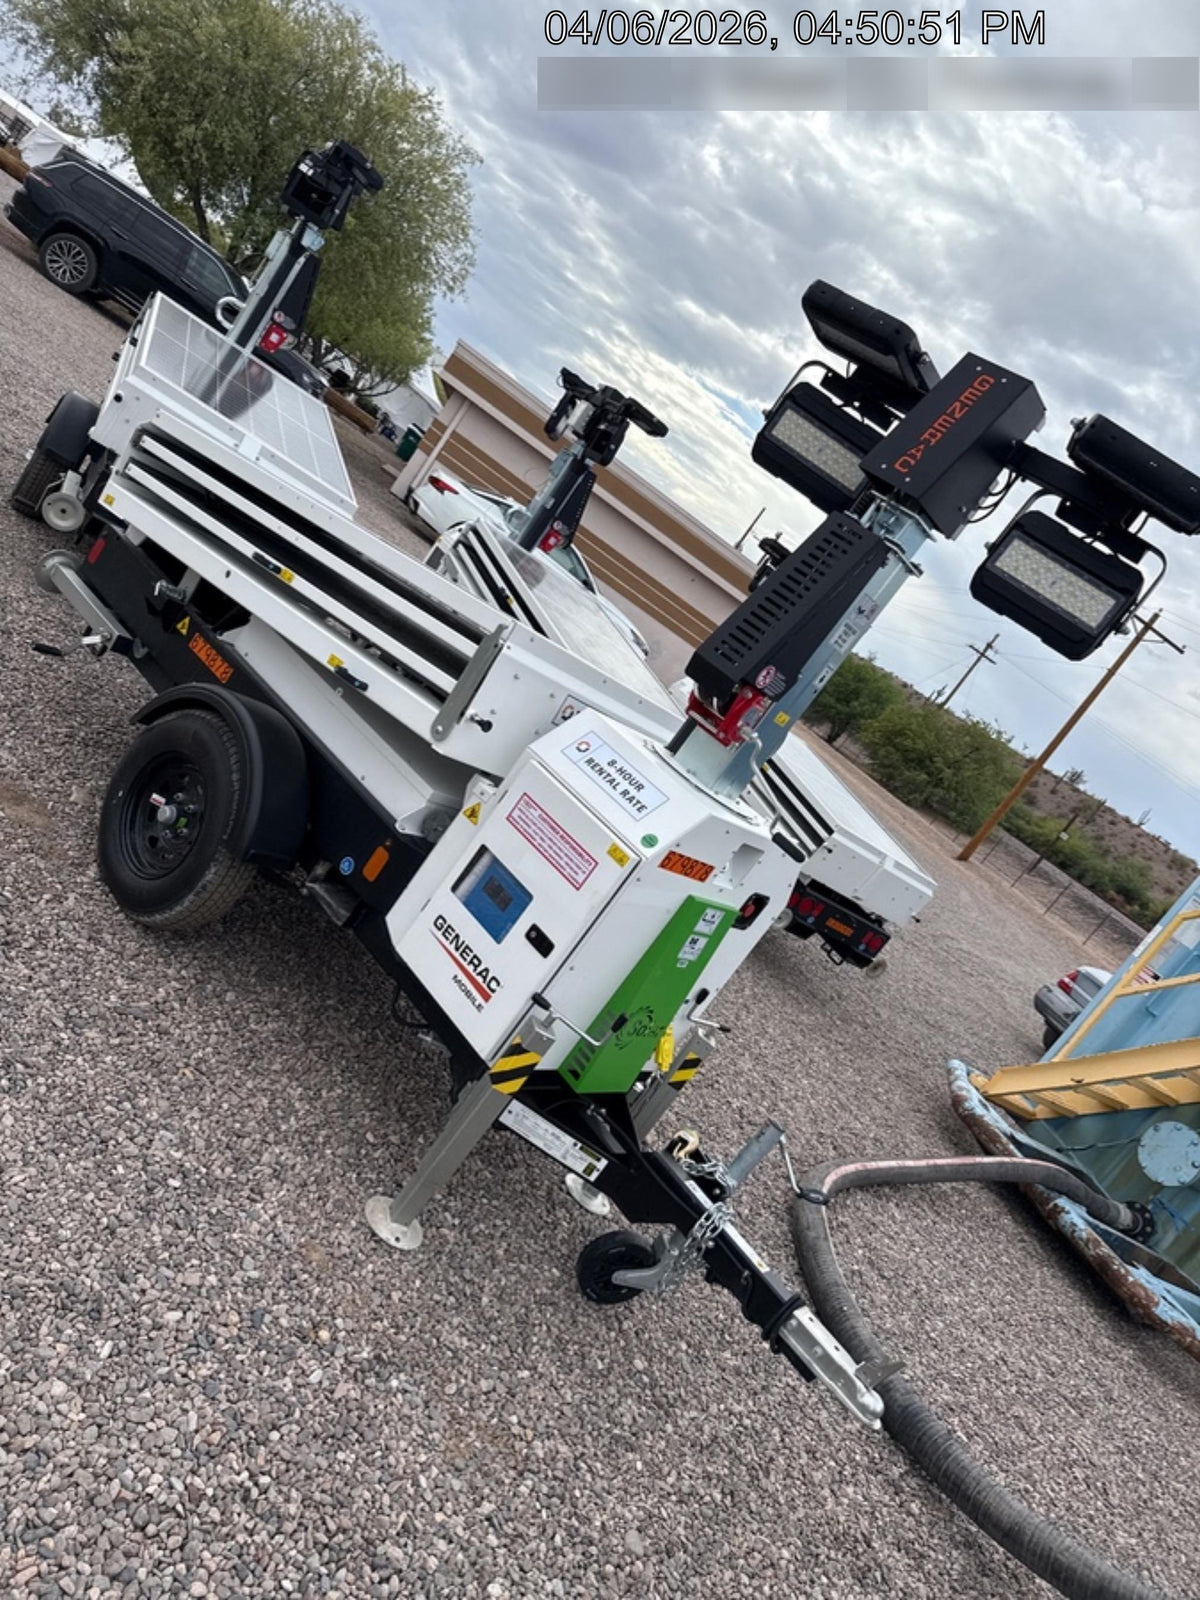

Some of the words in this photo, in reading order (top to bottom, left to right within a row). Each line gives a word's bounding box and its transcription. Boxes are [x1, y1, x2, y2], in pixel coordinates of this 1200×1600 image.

[894, 373, 996, 474] GENERAC
[584, 758, 620, 792] RENTAL
[620, 788, 648, 814] RATE
[607, 758, 645, 793] 8-HOUR
[433, 914, 501, 994] GENERAC
[451, 974, 485, 1013] MOBILE
